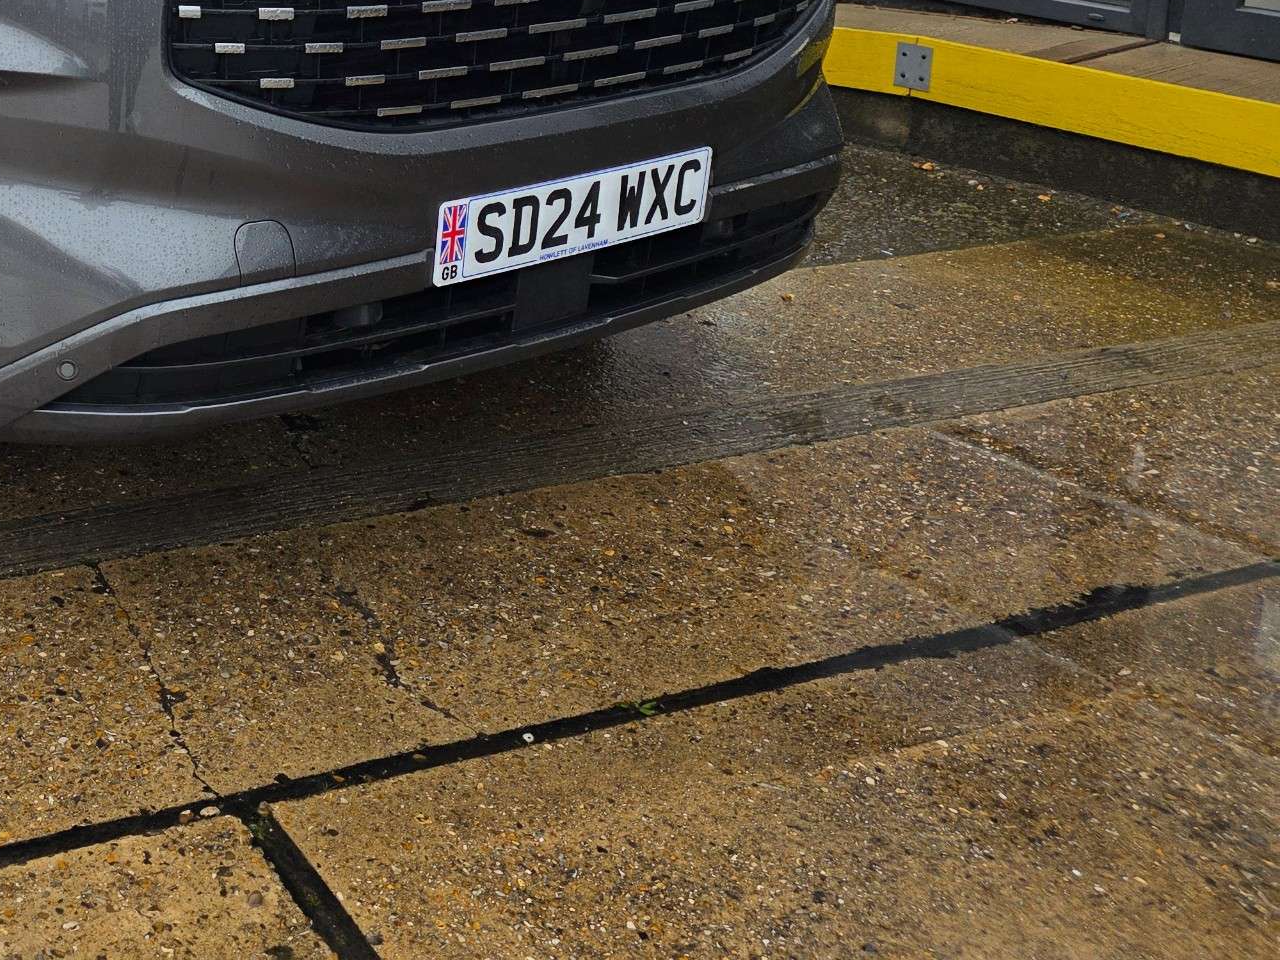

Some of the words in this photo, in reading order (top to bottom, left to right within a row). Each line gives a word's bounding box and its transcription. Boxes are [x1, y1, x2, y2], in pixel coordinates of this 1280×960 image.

[474, 181, 601, 264] SD24
[617, 158, 702, 232] WXC
[539, 248, 568, 261] HOWLETT
[577, 238, 609, 252] LAVENHAM
[441, 264, 458, 281] GB
